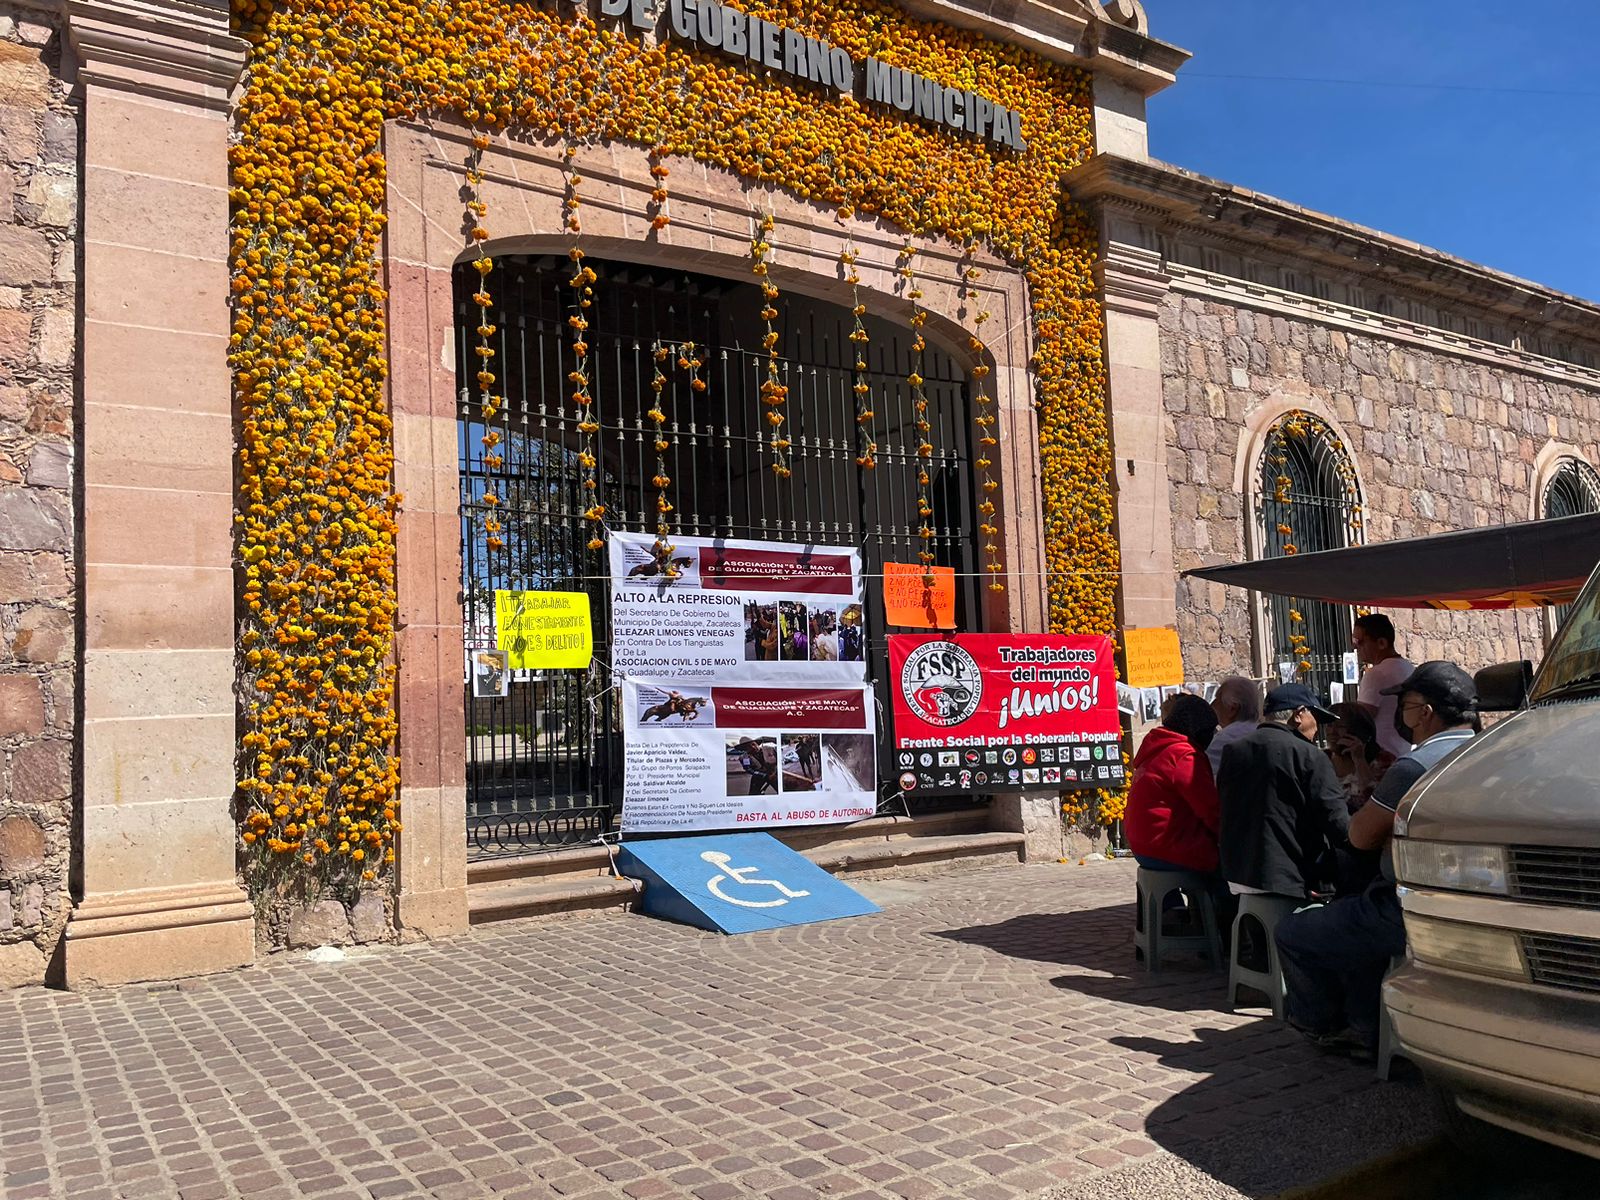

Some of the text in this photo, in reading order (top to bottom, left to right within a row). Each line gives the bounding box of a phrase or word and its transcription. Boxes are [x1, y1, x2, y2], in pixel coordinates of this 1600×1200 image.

[671, 0, 854, 93] GOBIERNO
[867, 56, 1027, 151] MUNICIPAL
[723, 561, 784, 570] ASOCIACIÓN
[725, 566, 783, 575] GUADALUPE
[614, 592, 741, 606] ALTO A LA REPRESION
[614, 608, 730, 618] Del Secretario De Gobierno Del
[614, 618, 650, 627] Municipio
[706, 620, 742, 628] Zacatecas
[614, 628, 735, 637] ELEAZAR LIMONES VENEGAS
[527, 634, 543, 651] ES
[614, 638, 724, 648] En Contra De Los Tianguistas
[614, 648, 621, 656] Y
[623, 648, 635, 656] De
[915, 644, 931, 657] POR
[999, 647, 1096, 664] Trabajadores
[614, 658, 670, 666] ASOCIACION
[671, 658, 693, 666] CIVIL
[713, 658, 737, 666] MAYO
[917, 651, 966, 680] FSSP
[627, 668, 669, 677] Guadalupe
[677, 668, 715, 676] Zacatecas
[903, 656, 917, 684] SOCIAL
[1012, 667, 1090, 682] del mundo
[904, 686, 924, 718] FRENTE
[966, 679, 981, 717] POPULAR
[923, 713, 967, 726] ZACATECAS
[901, 730, 1119, 749] Frente Social por la Soberanía Popular
[736, 807, 874, 822] BASTA AL ABUSO DE AUTORIDAD
